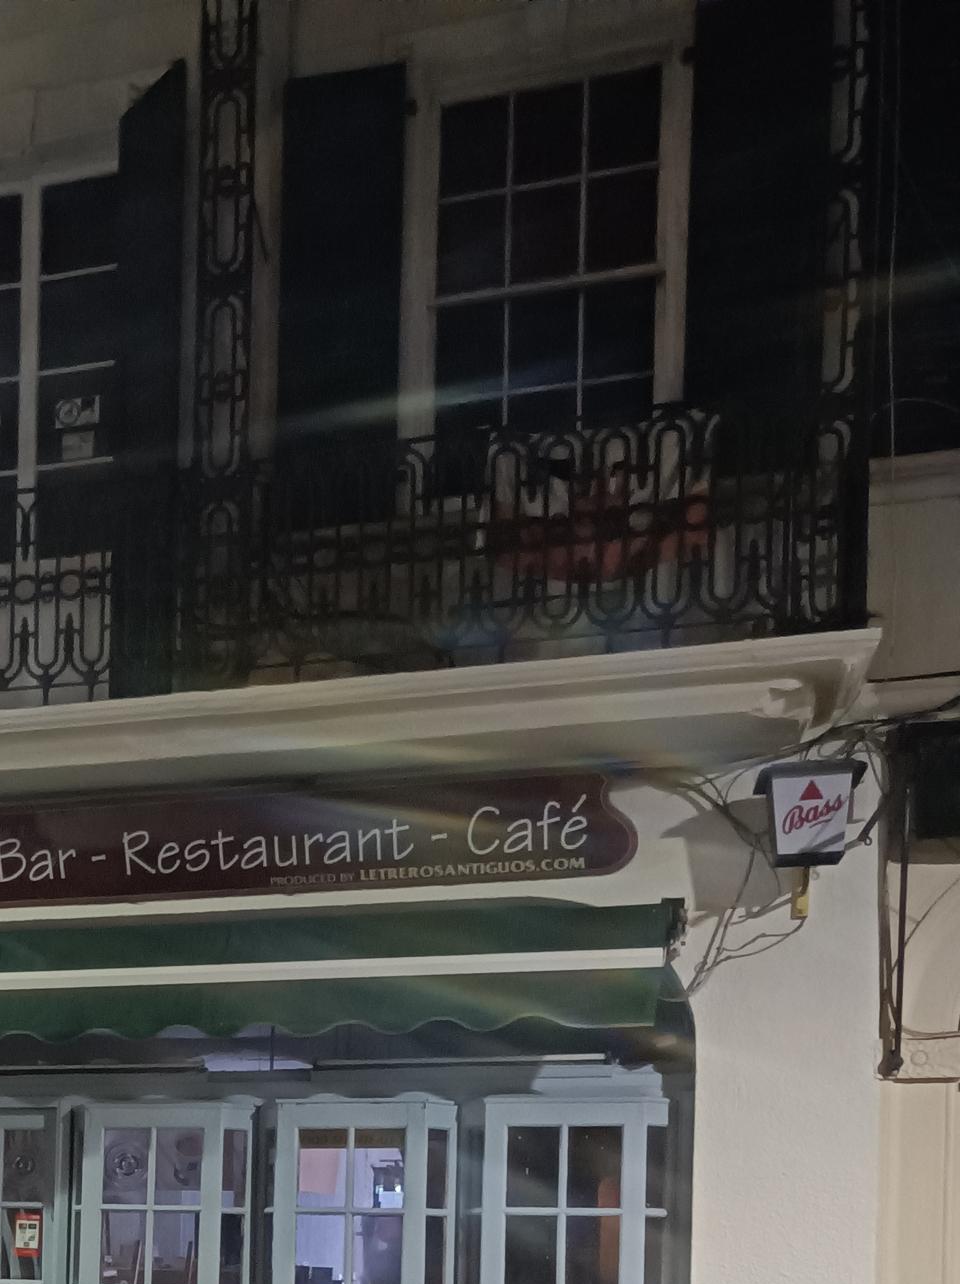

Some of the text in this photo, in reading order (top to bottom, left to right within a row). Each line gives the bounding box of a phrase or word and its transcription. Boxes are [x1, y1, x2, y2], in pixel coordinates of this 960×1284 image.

[121, 818, 415, 876] Restaurant
[466, 794, 589, 856] Café
[782, 795, 844, 835] Bass
[270, 857, 585, 886] PRODUCED BY LETREROSANTIGUOS.COM
